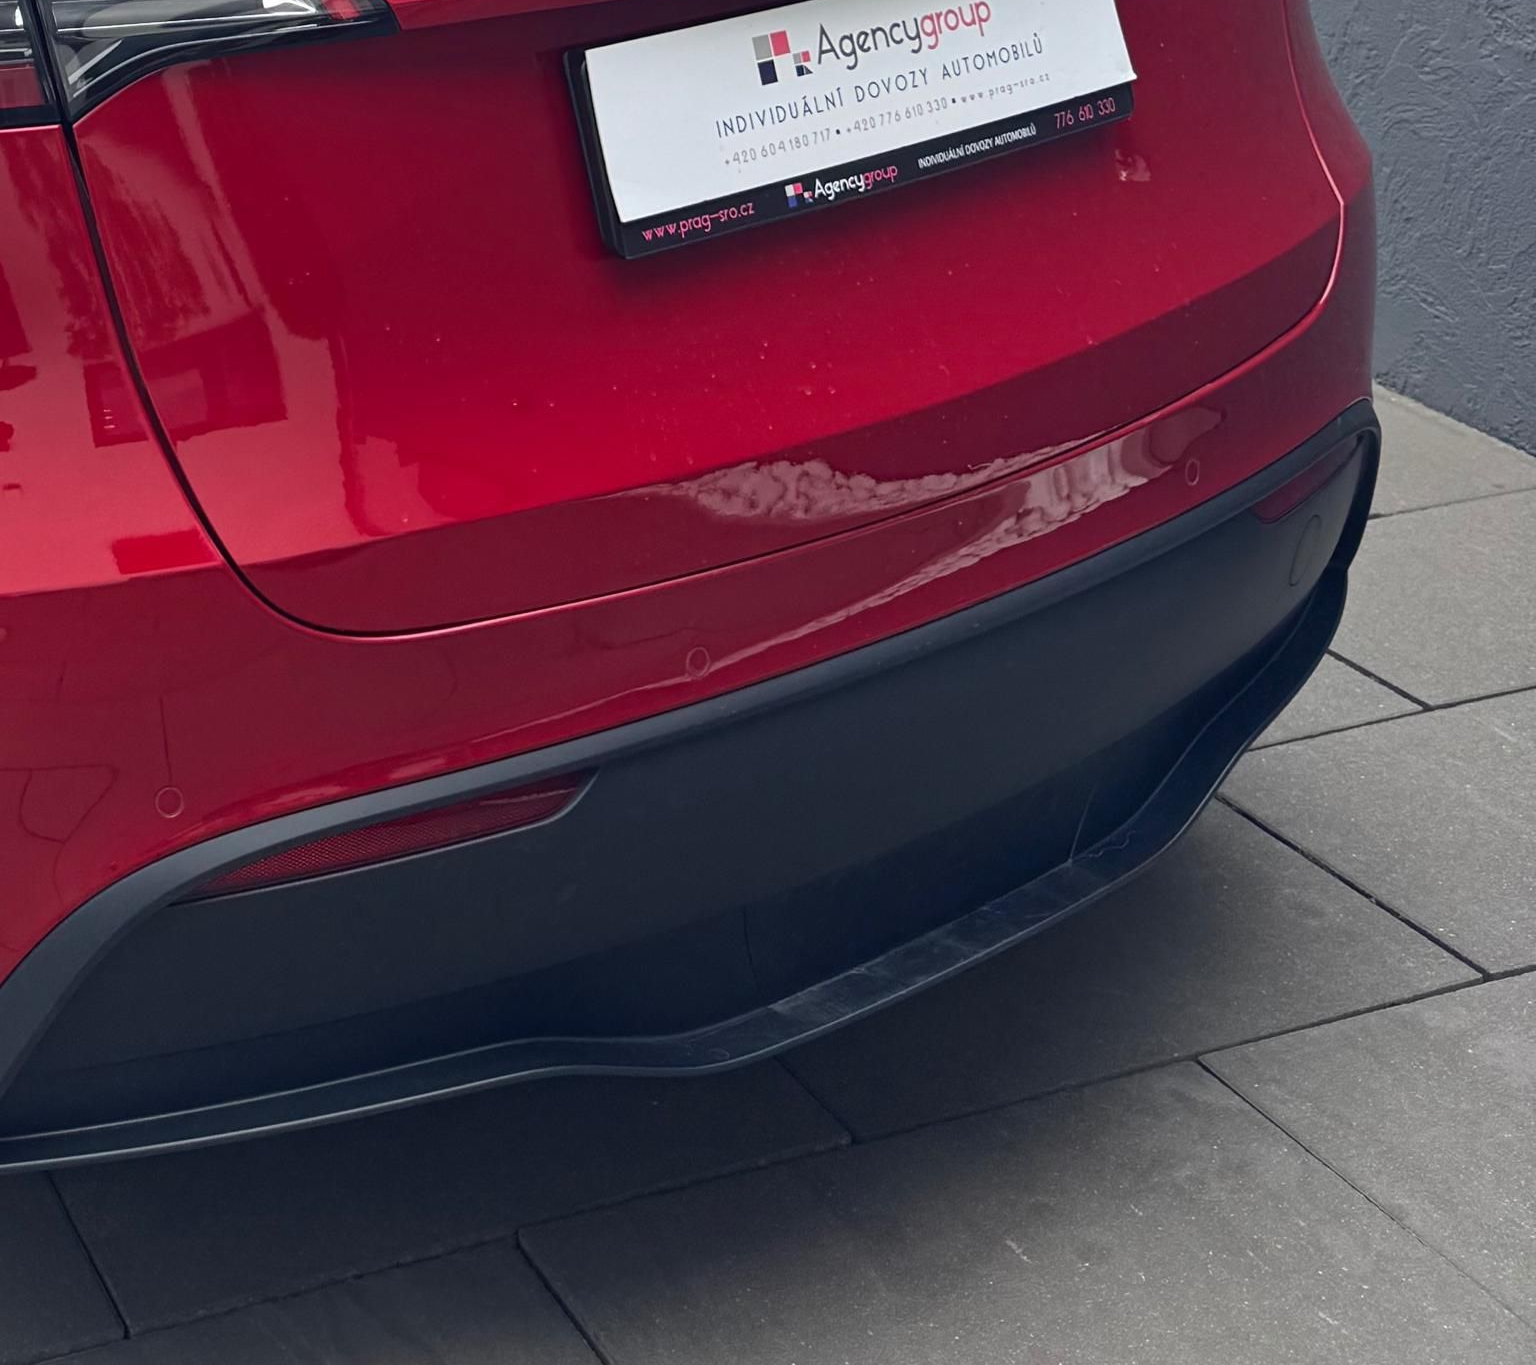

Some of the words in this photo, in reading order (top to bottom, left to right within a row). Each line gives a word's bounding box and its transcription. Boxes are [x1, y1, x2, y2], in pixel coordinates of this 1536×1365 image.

[816, 0, 992, 71] Agencygroup
[715, 86, 845, 139] INDIVIDUÁLNÍ
[853, 66, 929, 104] DOVOZY
[940, 31, 1044, 81] AUTOMOBILŮ
[812, 127, 832, 142] 717
[878, 109, 902, 127] 776
[904, 103, 924, 120] 610
[926, 96, 949, 114] 330
[1053, 111, 1075, 130] 776
[1077, 103, 1095, 122] 610
[1096, 96, 1116, 117] 330
[917, 144, 965, 170] INDIVIDUÁLNÍ
[964, 136, 994, 156] DOVOZY
[813, 164, 899, 200] Agencygroup
[640, 201, 755, 243] www.prag-sro.cz
